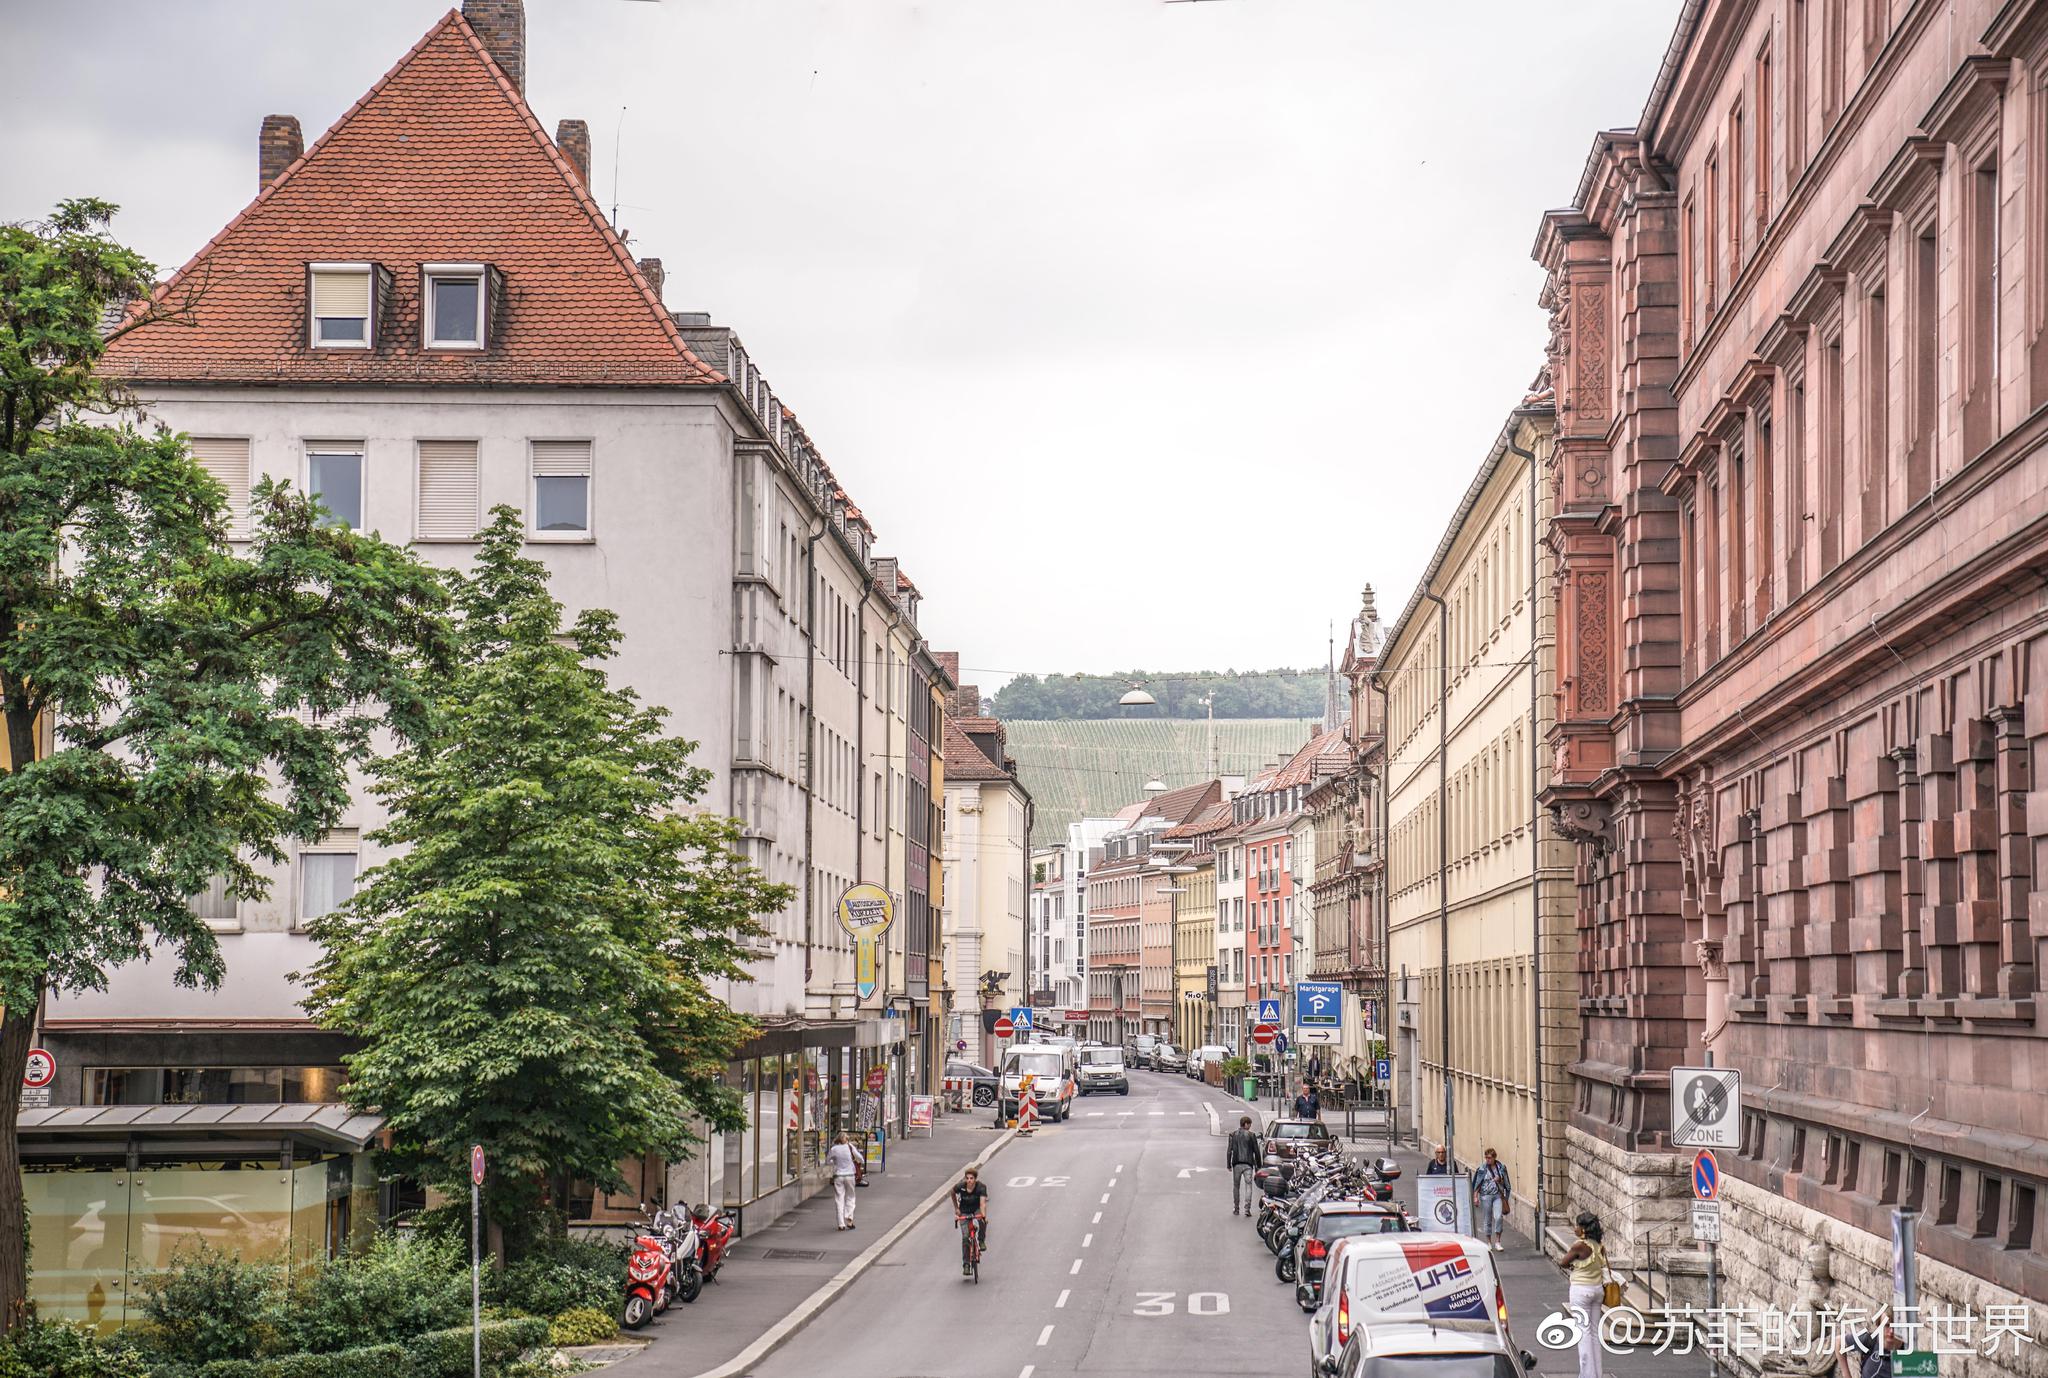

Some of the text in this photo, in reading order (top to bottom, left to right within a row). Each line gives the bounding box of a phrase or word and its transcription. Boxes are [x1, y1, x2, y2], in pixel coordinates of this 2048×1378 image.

[1299, 985, 1339, 993] Marktgarage
[1689, 1129, 1724, 1143] ZONE
[1693, 1202, 1718, 1211] Ladezone
[1413, 1260, 1472, 1291] UHL
[1449, 1286, 1478, 1301] STAHLBAU
[1133, 1292, 1230, 1316] 30
[1380, 1293, 1420, 1312] Kundendienst
[1448, 1294, 1481, 1311] HALLENBAU
